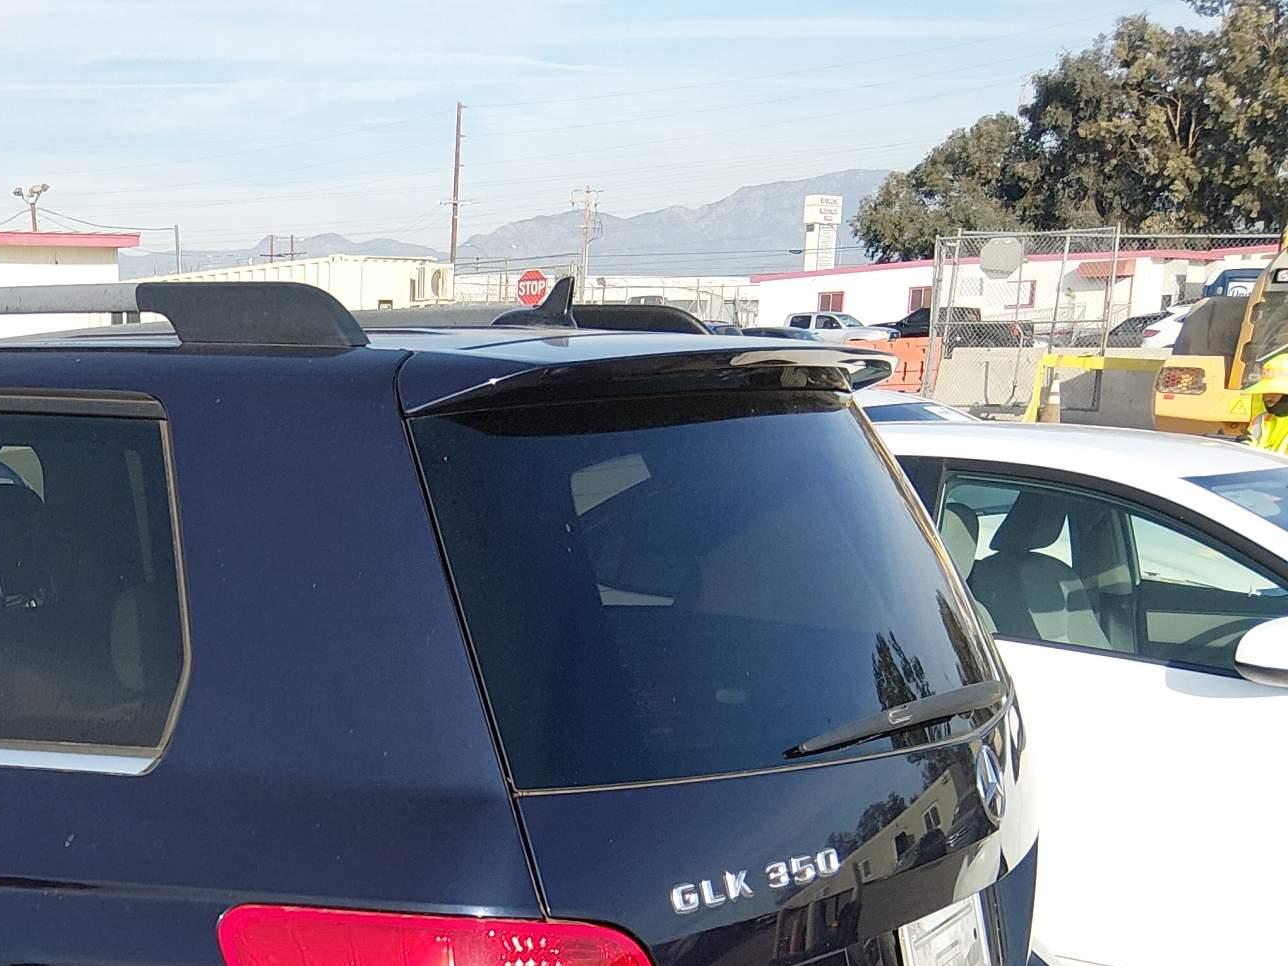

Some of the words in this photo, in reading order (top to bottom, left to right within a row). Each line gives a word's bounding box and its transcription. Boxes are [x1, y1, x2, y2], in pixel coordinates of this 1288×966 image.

[518, 280, 545, 296] STOP
[670, 869, 754, 915] GLK
[765, 847, 841, 889] 350
